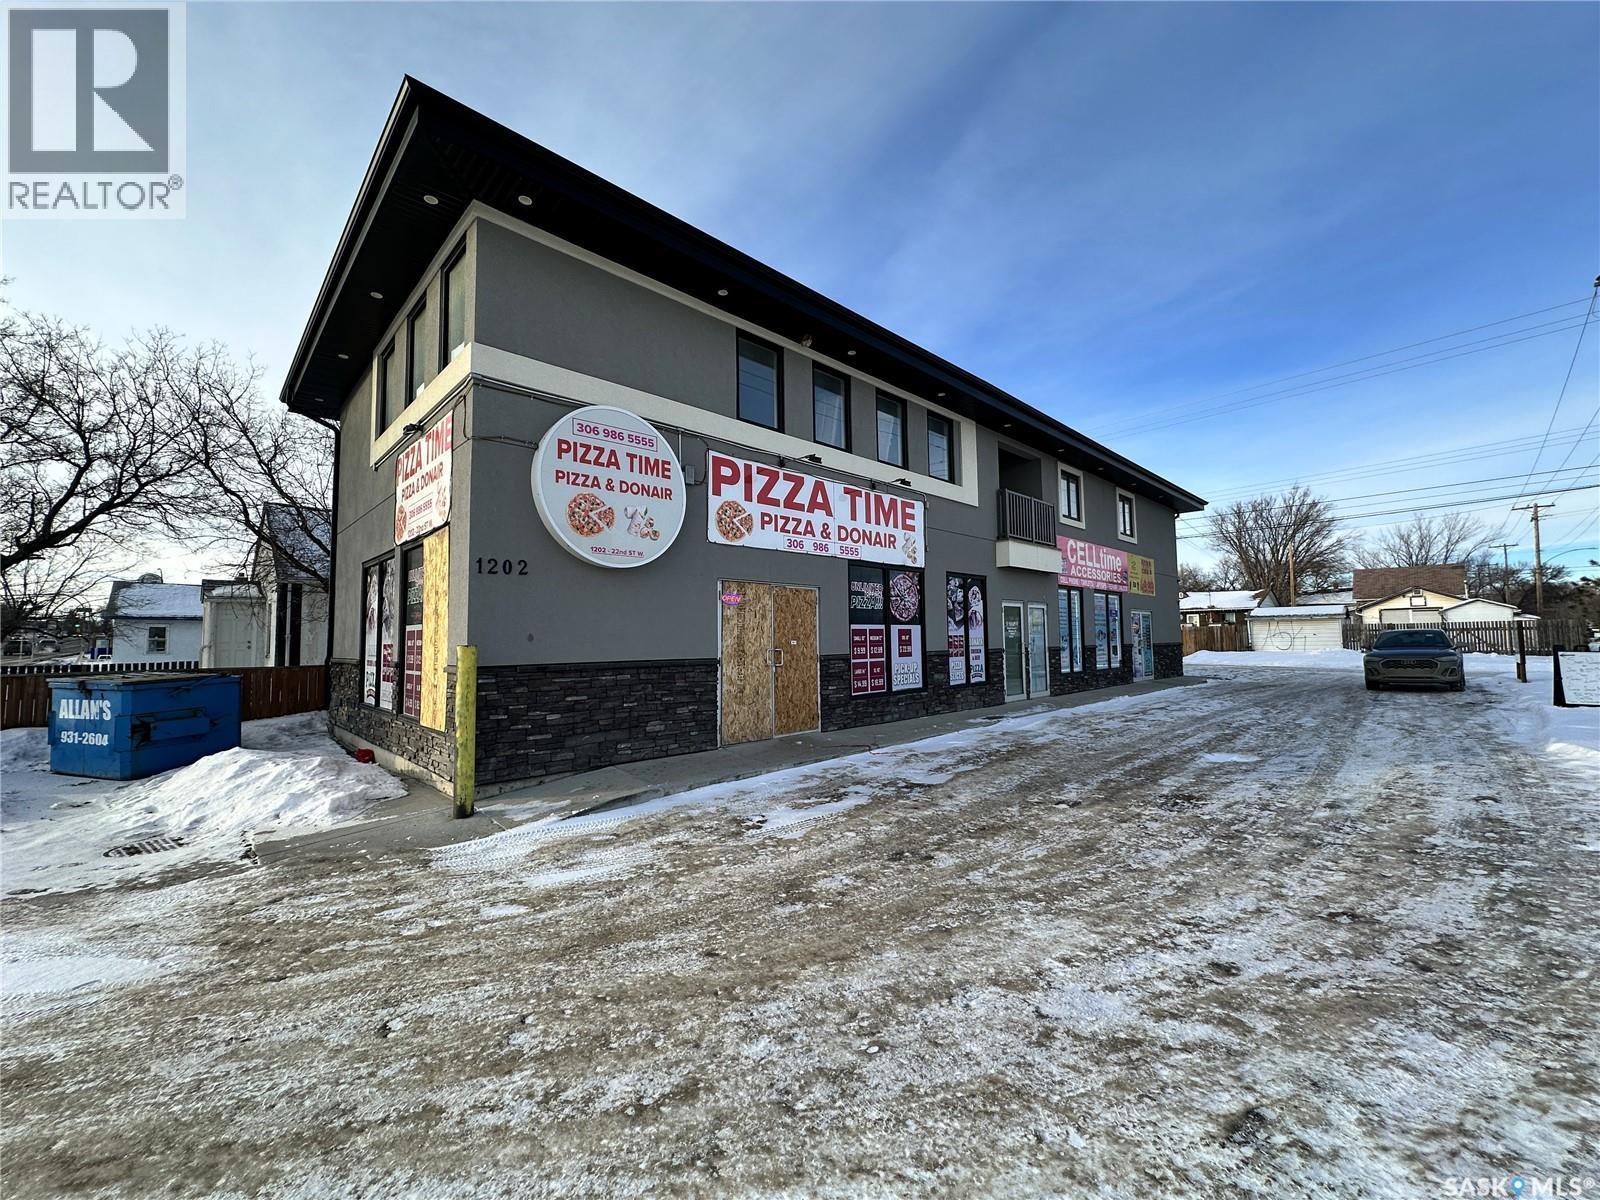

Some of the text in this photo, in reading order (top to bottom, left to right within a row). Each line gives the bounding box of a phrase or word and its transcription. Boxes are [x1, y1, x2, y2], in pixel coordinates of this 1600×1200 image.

[576, 422, 655, 448] 306 986 5555
[397, 414, 452, 487] PIZZA TIME
[557, 438, 672, 480] PIZZA TIME
[401, 482, 415, 503] PIZZA
[420, 461, 444, 491] DONAIR
[555, 469, 673, 501] PIZZA & DONAIR
[711, 455, 916, 533] PIZZA TIME
[760, 511, 897, 550] PIZZA & DONAIR
[590, 546, 606, 554] 1202
[786, 538, 860, 557] 306 986 5555
[1067, 539, 1122, 572] CELLtime
[475, 557, 529, 576] 1202
[1070, 564, 1121, 583] ACCESSORIES
[721, 594, 742, 603] OPEN
[893, 672, 920, 686] SPECIALS
[59, 699, 111, 720] ALLAN'S
[60, 731, 109, 746] 931-2604
